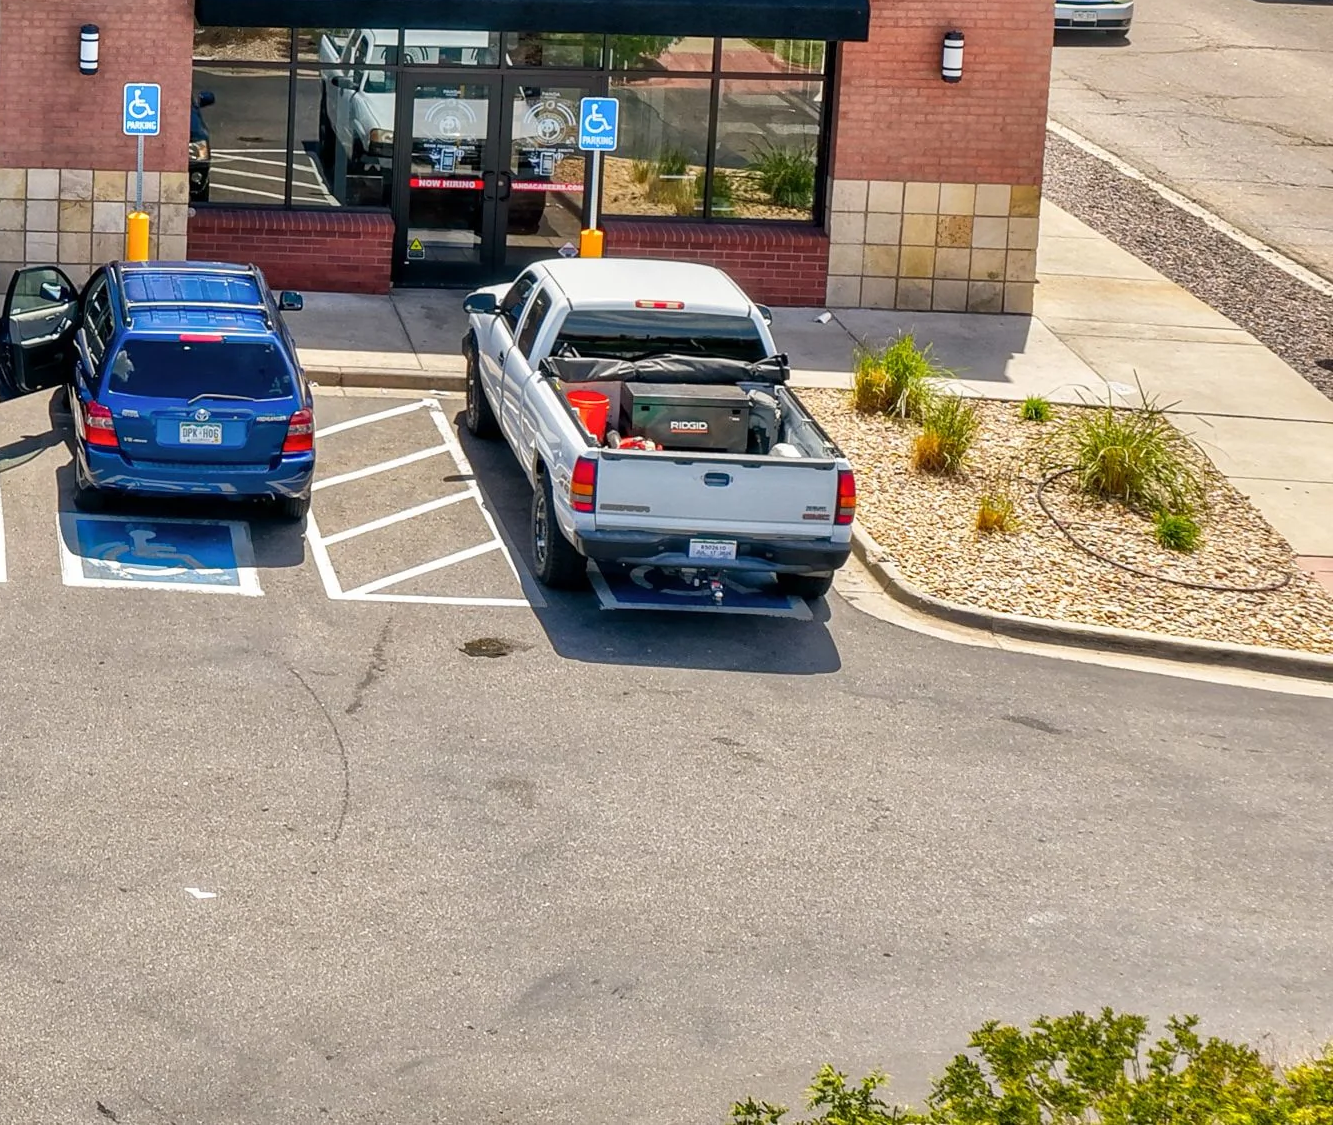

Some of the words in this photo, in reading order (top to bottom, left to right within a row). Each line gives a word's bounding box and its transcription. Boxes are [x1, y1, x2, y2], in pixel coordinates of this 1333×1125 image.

[126, 120, 157, 130] PARKING
[582, 135, 614, 145] PARKING
[443, 180, 476, 188] HIRING
[670, 421, 708, 429] RIDGID
